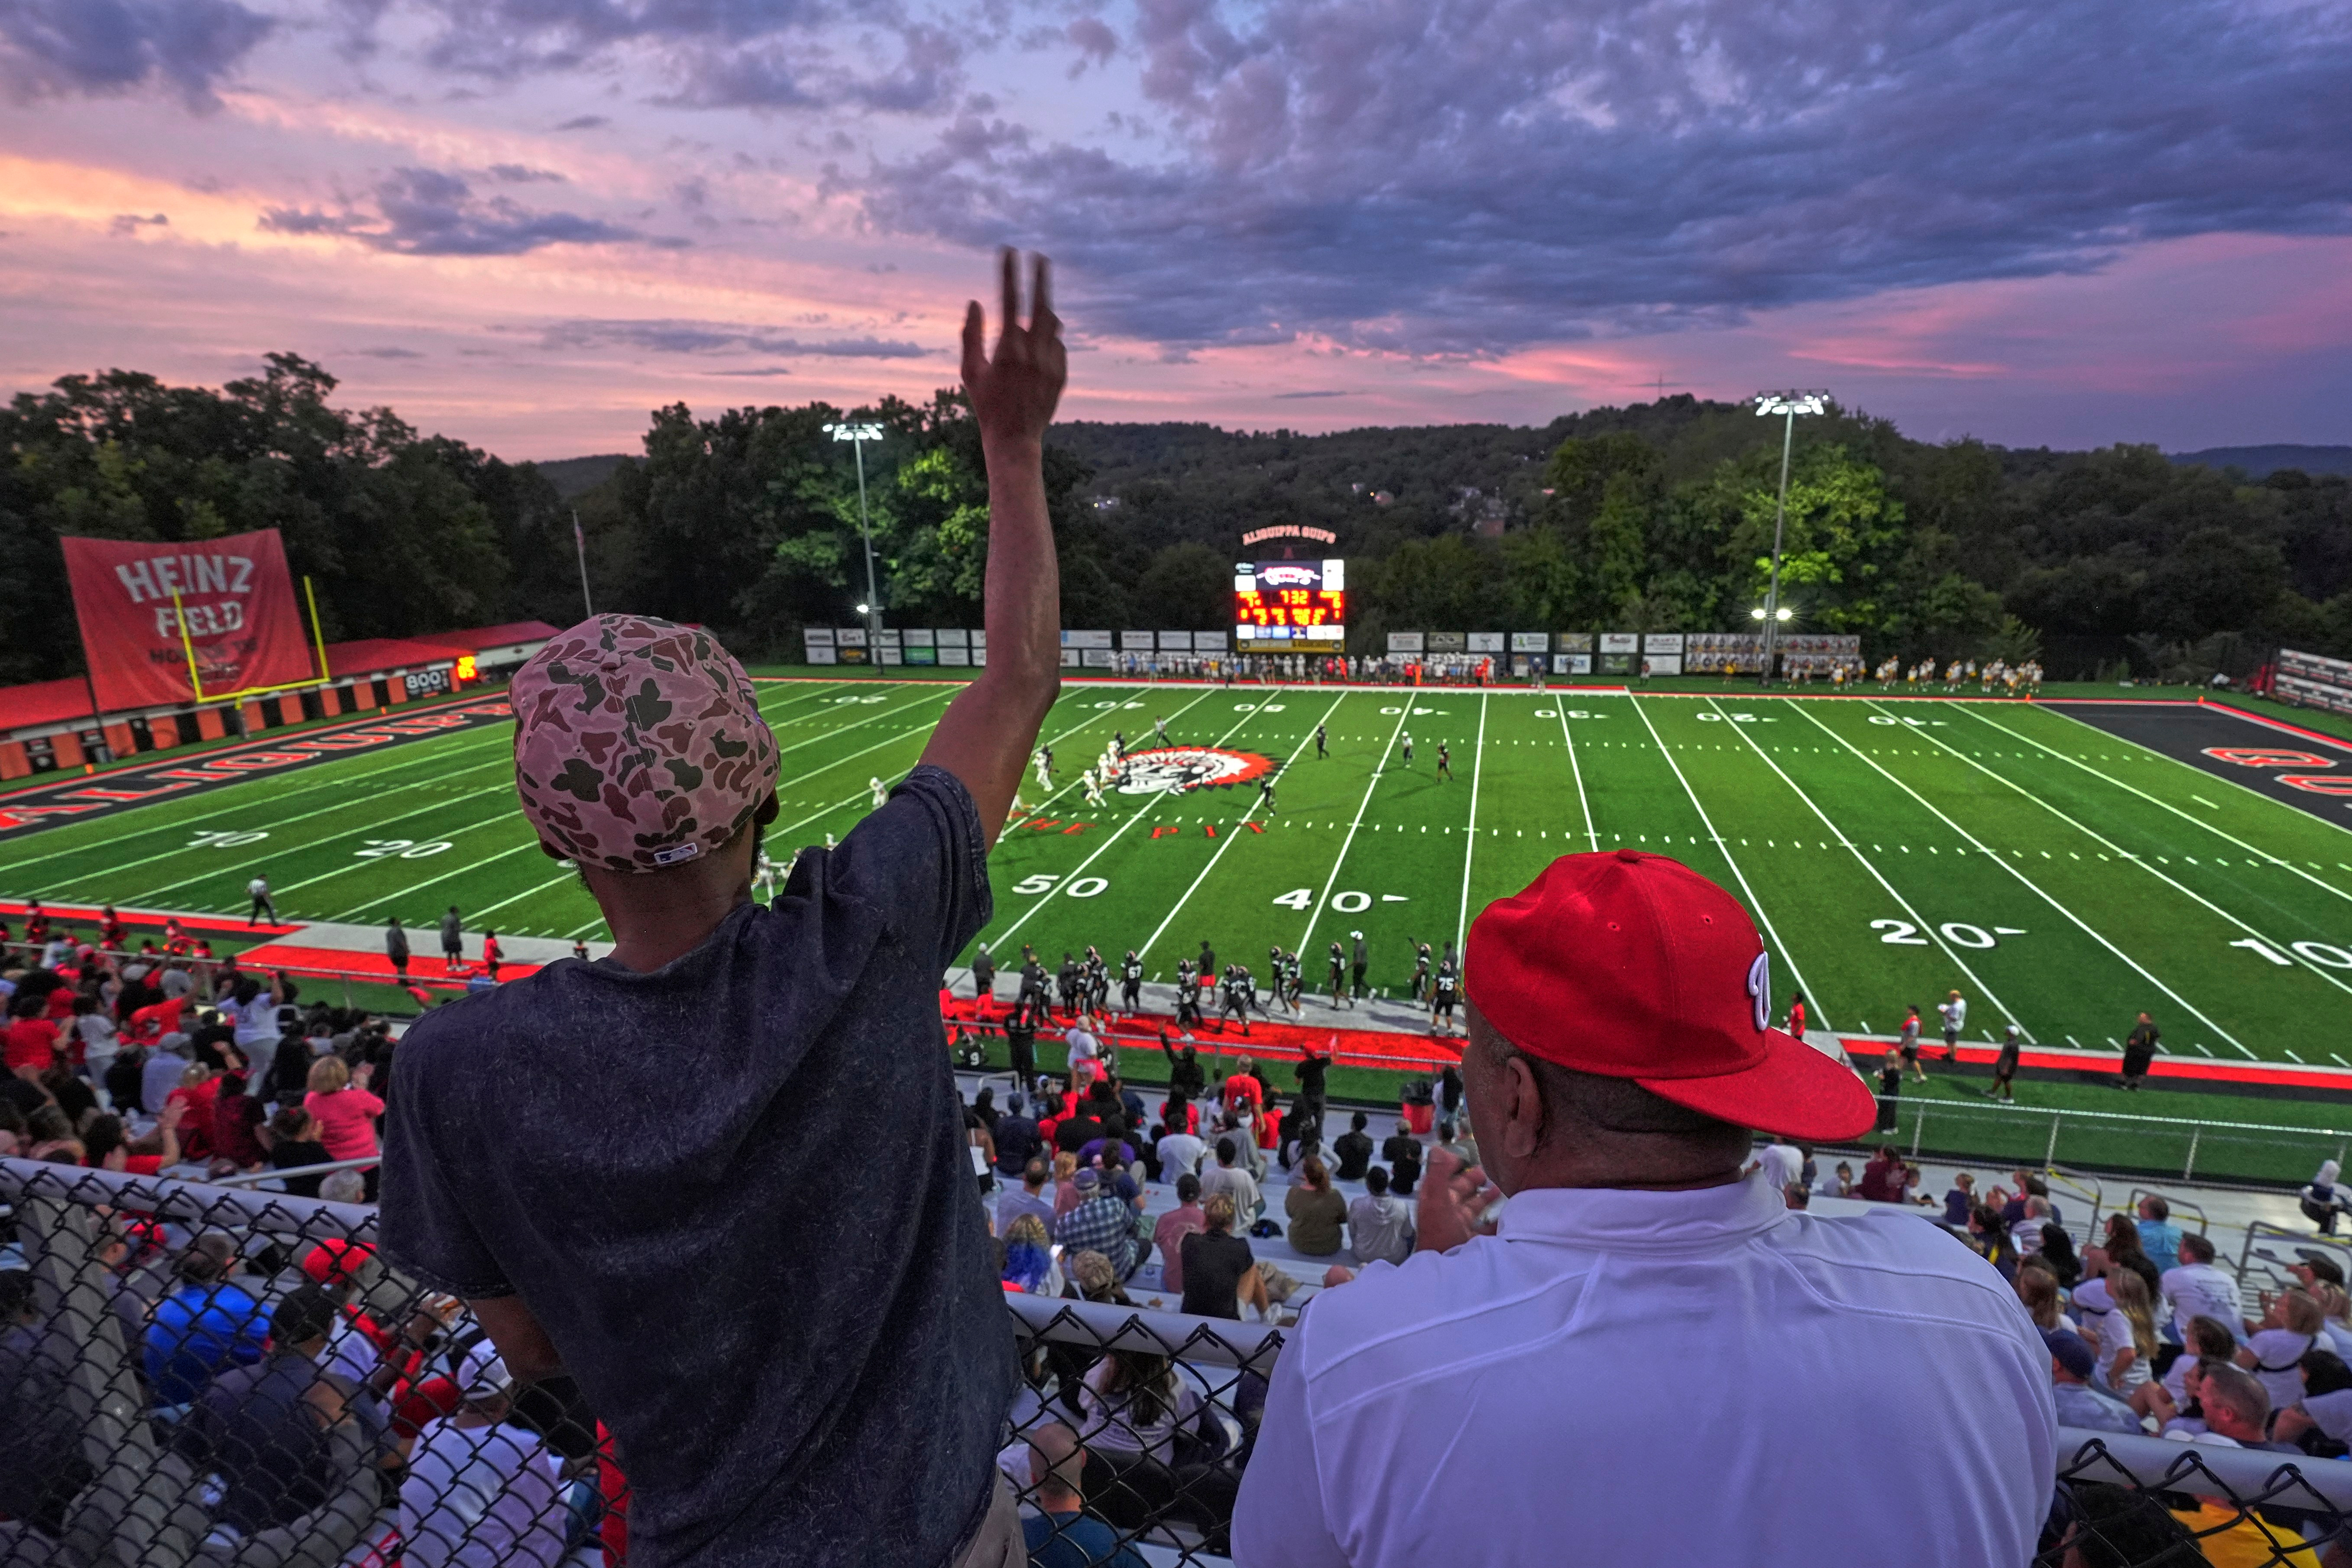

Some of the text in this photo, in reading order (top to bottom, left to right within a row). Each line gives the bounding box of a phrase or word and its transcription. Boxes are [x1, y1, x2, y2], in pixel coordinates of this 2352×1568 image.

[1242, 525, 1336, 545] ALIQUIPPA QUIPS
[115, 554, 254, 603] HEINZ
[155, 600, 244, 638] FELD
[406, 671, 442, 690] 800
[1234, 703, 1286, 713] 50
[1380, 706, 1434, 716] 40
[1696, 712, 1757, 722] 20
[1868, 716, 1926, 726] 10
[1149, 820, 1269, 839] PIT
[353, 839, 454, 859] 20
[1011, 874, 1109, 898] 50
[1272, 888, 1372, 913] 40
[1869, 919, 1996, 949] 20
[2229, 938, 2352, 969] 10
[1438, 977, 1455, 991] 75
